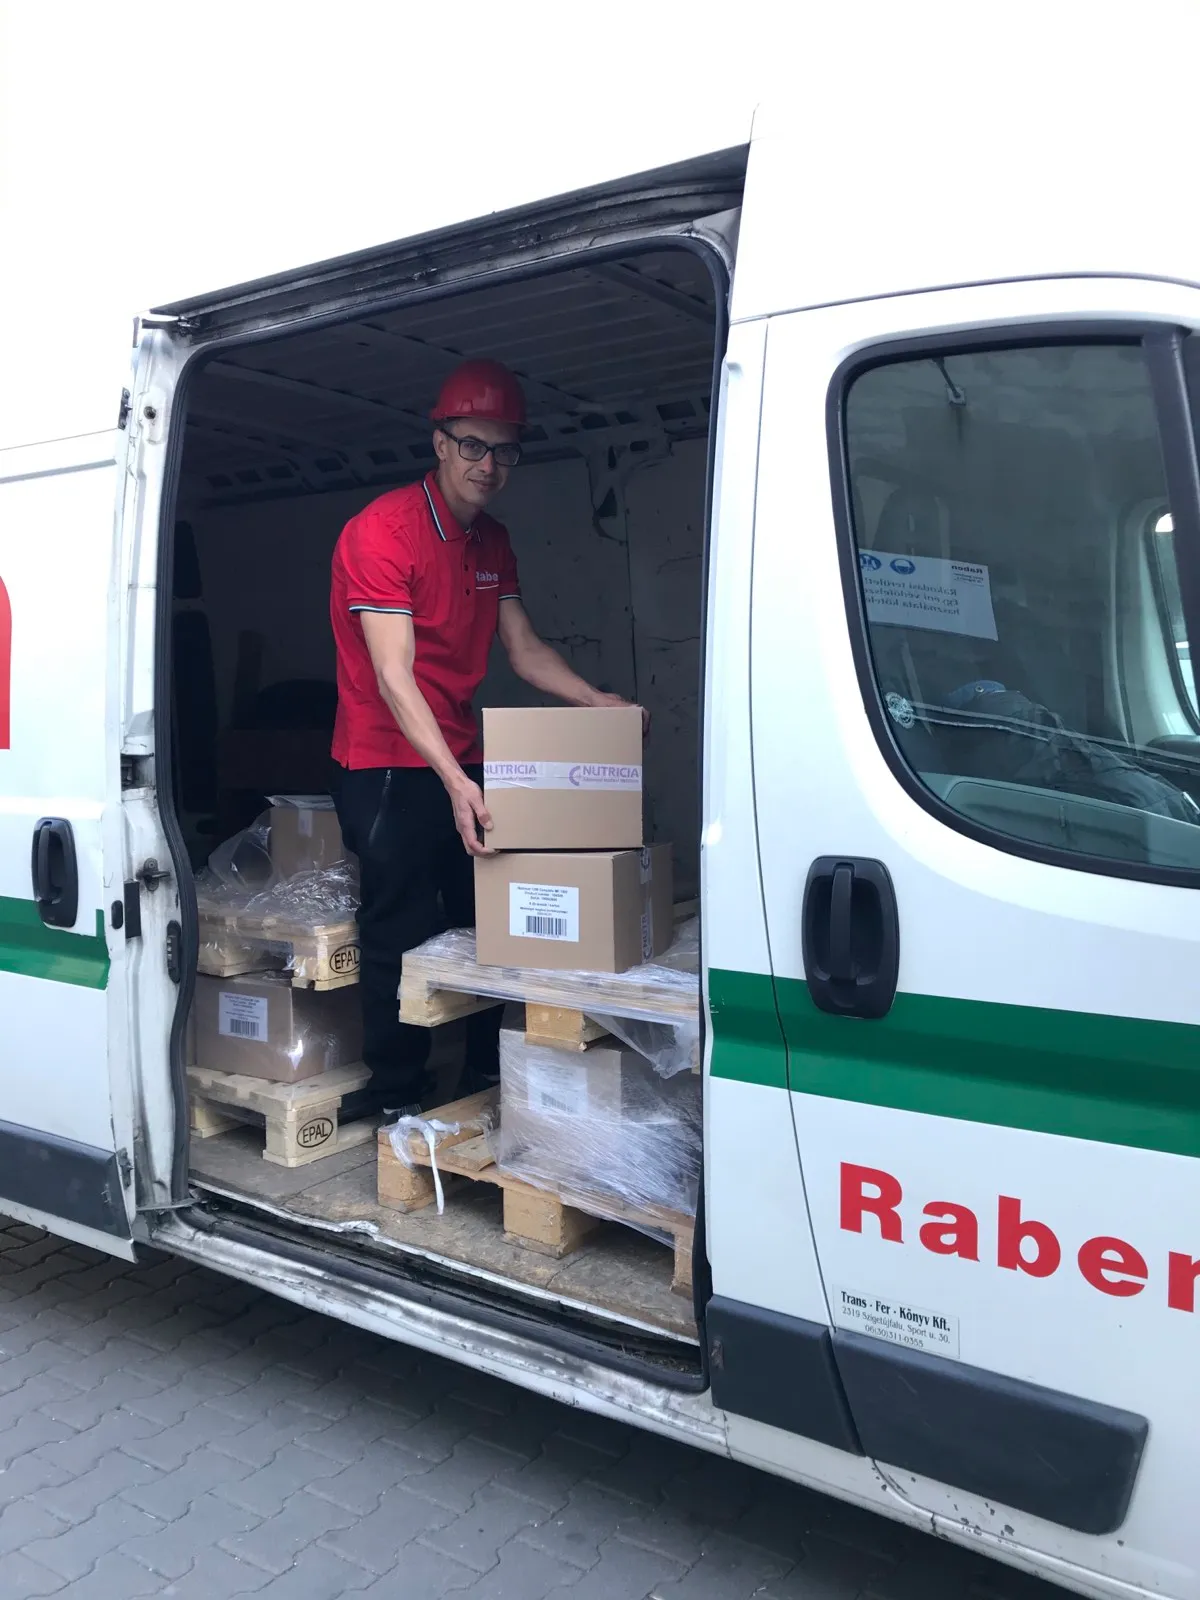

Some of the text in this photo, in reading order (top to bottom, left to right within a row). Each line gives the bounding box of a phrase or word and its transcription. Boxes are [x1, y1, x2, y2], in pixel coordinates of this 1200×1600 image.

[583, 765, 640, 778] NUTRICIA
[334, 949, 360, 970] EPAL
[302, 1123, 329, 1144] EPAL
[841, 1291, 867, 1308] Trans
[875, 1300, 890, 1314] Fer
[899, 1306, 930, 1327] Könyv
[932, 1315, 951, 1332] Kft.
[842, 1306, 861, 1317] 2319
[907, 1324, 927, 1338] Sport
[929, 1332, 936, 1340] u.
